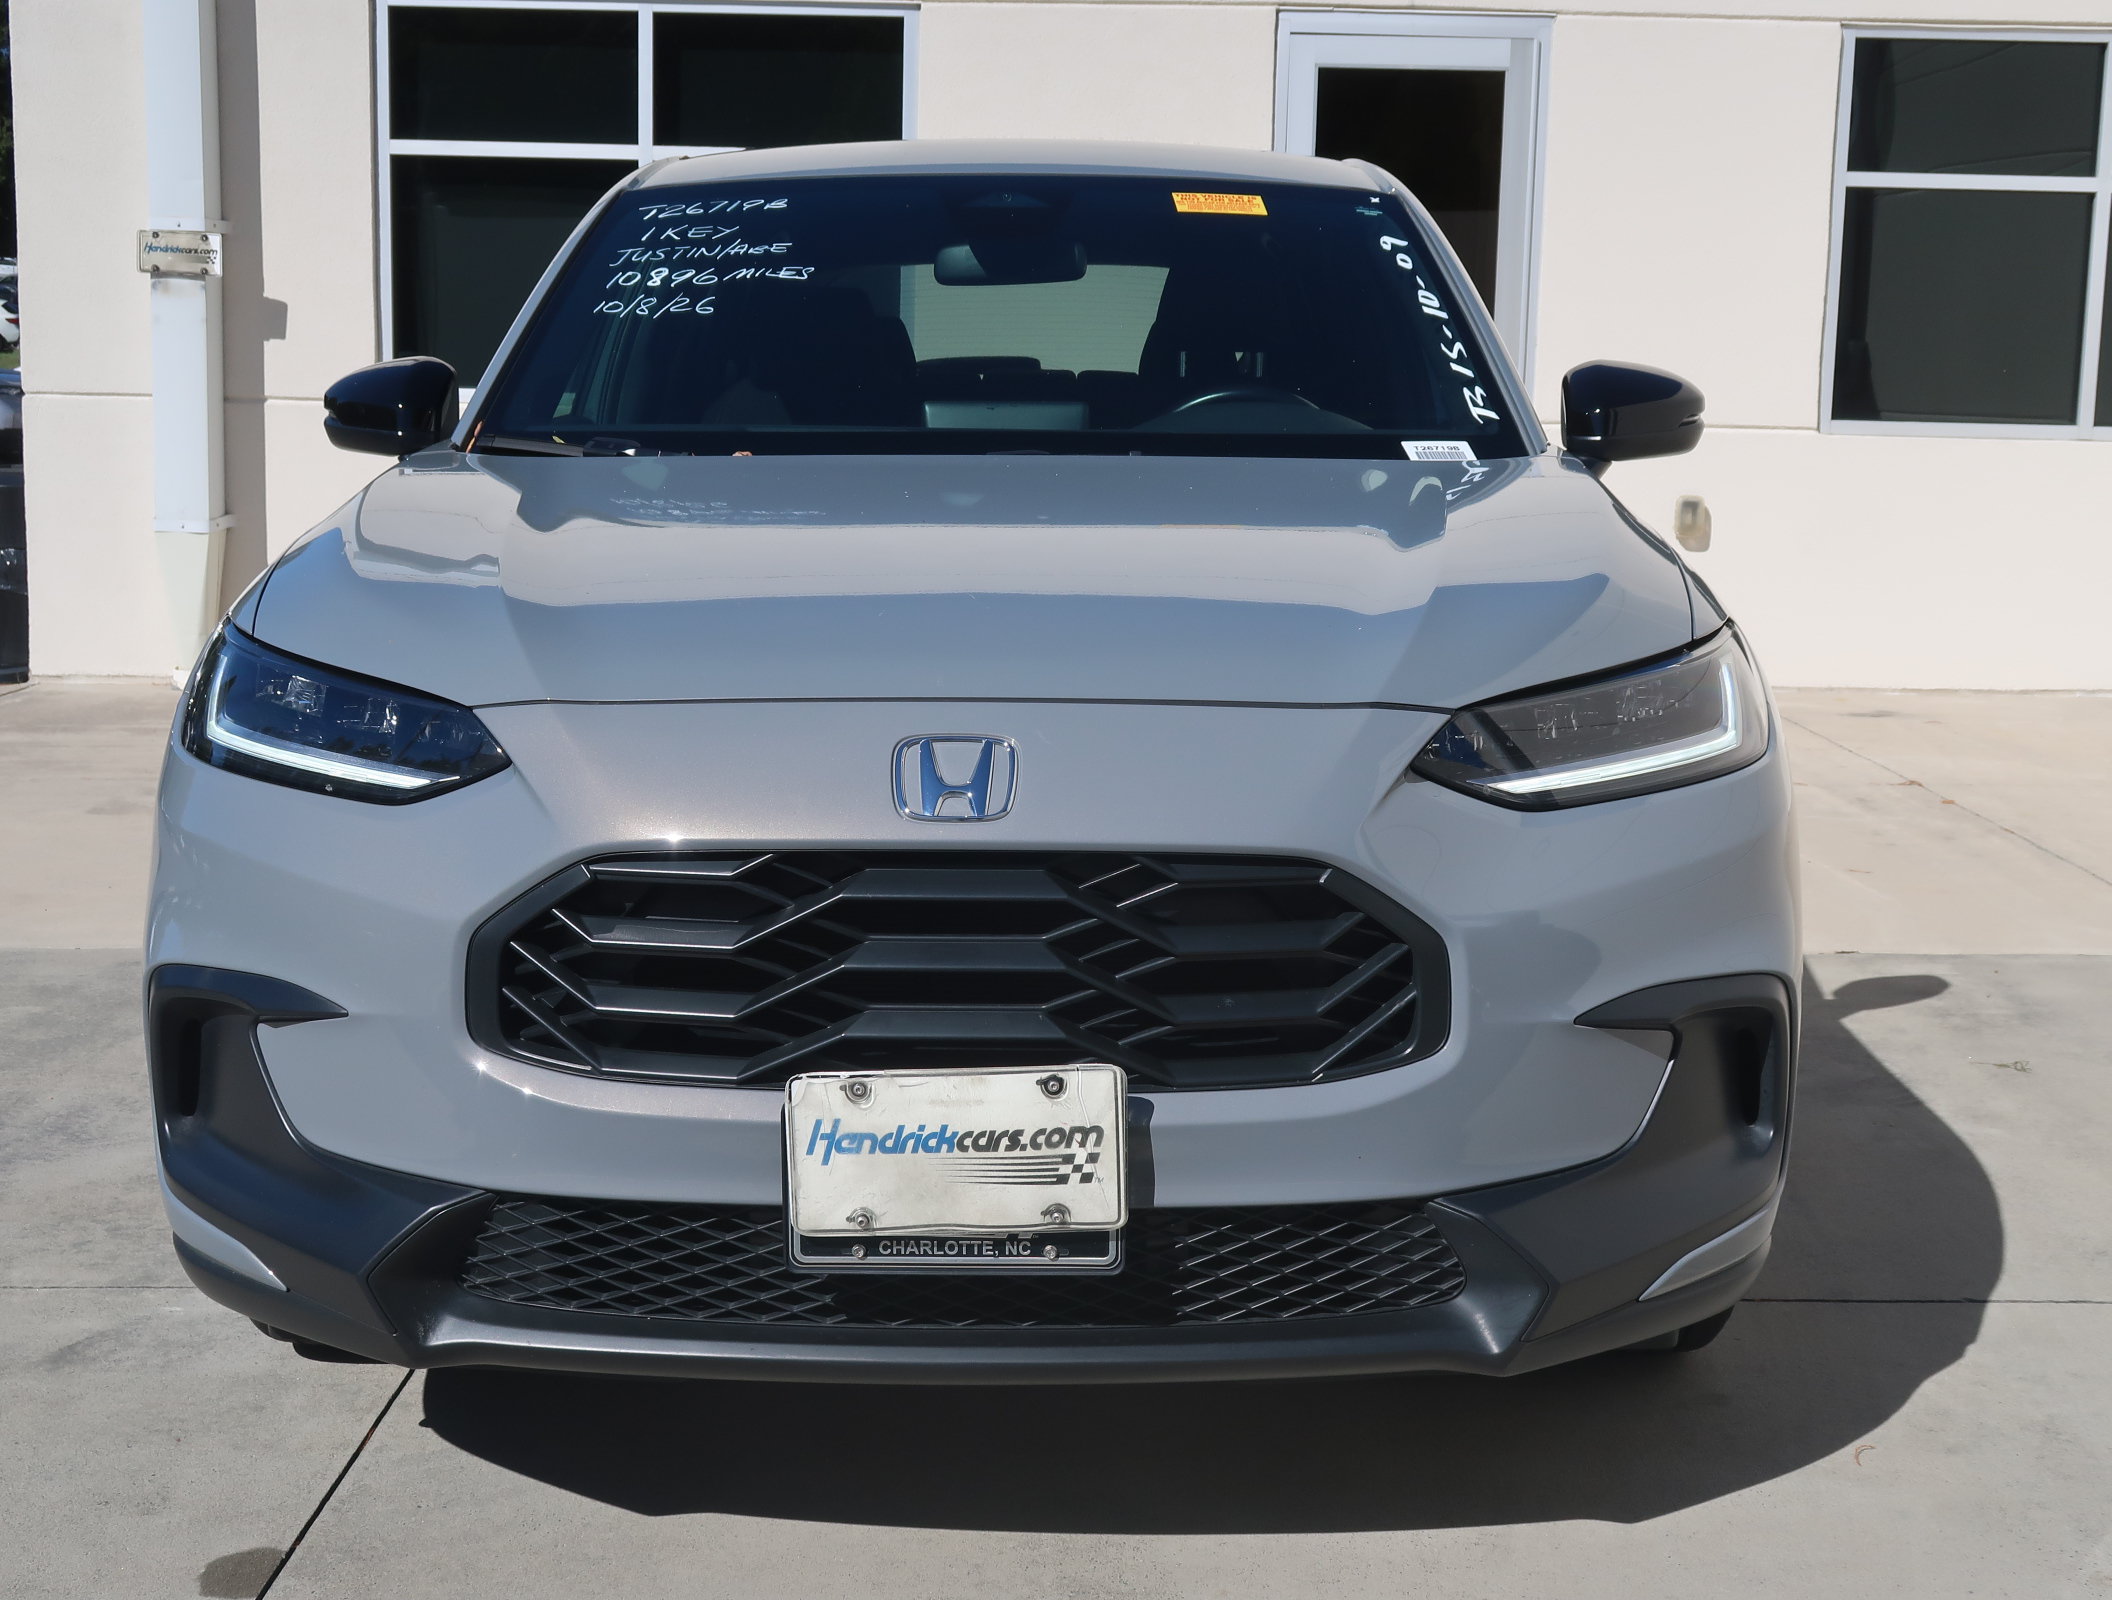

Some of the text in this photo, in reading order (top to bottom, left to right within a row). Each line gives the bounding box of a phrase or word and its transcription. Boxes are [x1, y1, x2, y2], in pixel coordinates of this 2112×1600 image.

[638, 198, 788, 220] T26719B
[143, 241, 218, 255] Hendrickcars.com
[606, 266, 815, 289] 10896 MILES
[593, 292, 716, 319] 10/8/26
[805, 1118, 1105, 1167] Hendrickcars.com
[878, 1240, 1031, 1257] CHARLOTTE, NC
